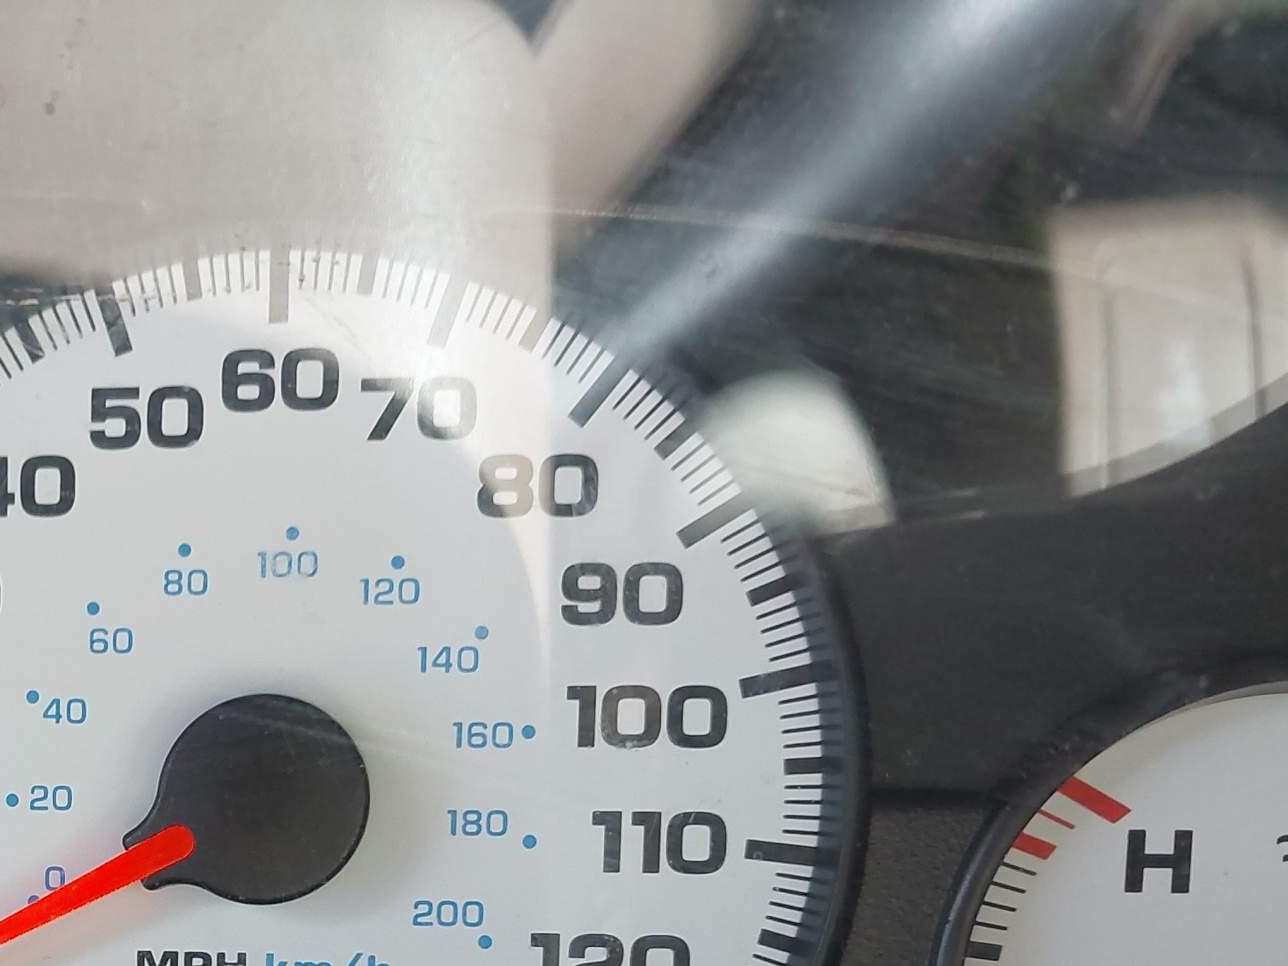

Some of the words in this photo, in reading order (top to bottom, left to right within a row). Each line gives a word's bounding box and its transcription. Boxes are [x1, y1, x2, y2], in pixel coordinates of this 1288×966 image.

[220, 347, 340, 414] 60
[89, 385, 205, 451] 50
[360, 376, 479, 442] 70
[476, 453, 599, 519] 80
[257, 550, 318, 579] 100
[162, 568, 209, 597] 80
[360, 576, 421, 606] 120
[560, 561, 684, 627] 90
[88, 626, 135, 655] 60
[416, 644, 480, 674] 140
[42, 697, 88, 725] 40
[566, 684, 728, 749] 100
[453, 720, 514, 749] 160
[28, 784, 74, 812] 20
[446, 808, 509, 837] 180
[591, 809, 728, 874] 110
[1124, 829, 1194, 894] H
[43, 865, 67, 892] 0
[411, 900, 485, 928] 200
